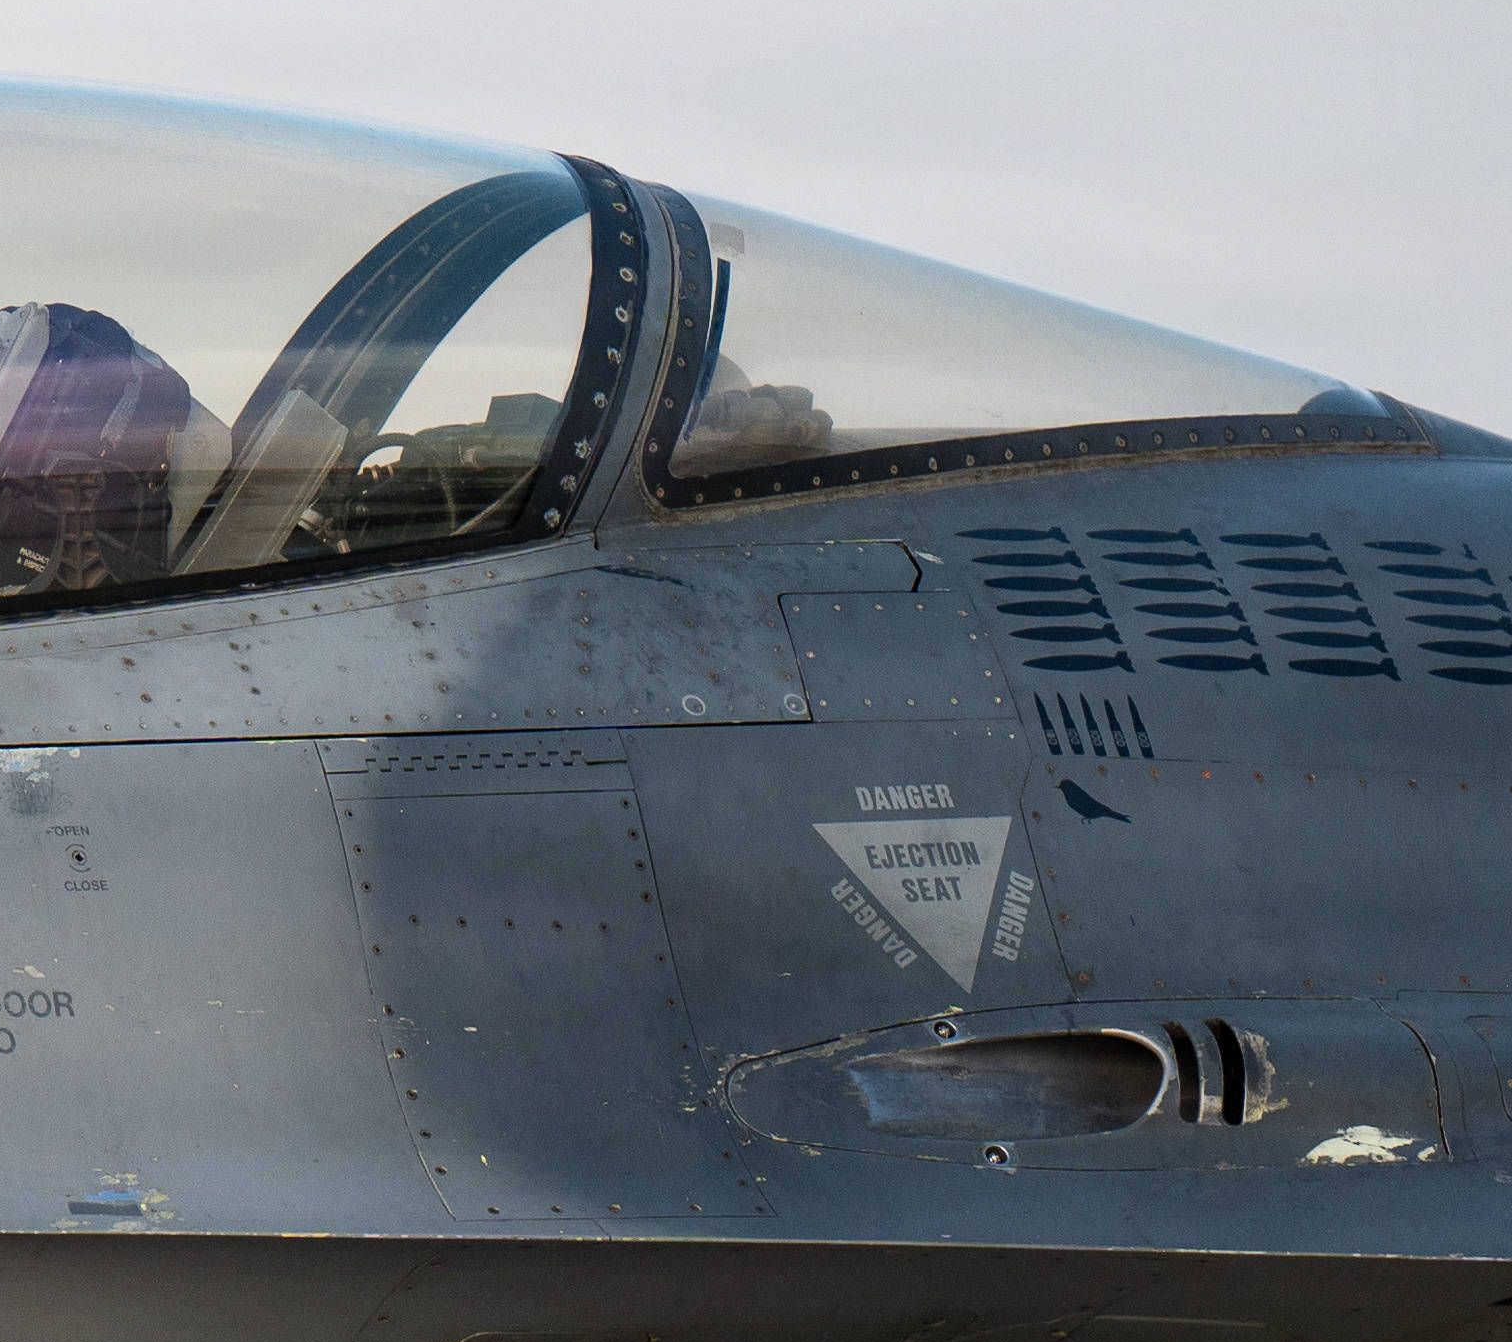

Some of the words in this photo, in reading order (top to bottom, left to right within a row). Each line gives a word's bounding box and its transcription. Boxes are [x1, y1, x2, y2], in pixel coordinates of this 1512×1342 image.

[855, 783, 956, 812] DANGER
[54, 826, 90, 836] OPEN
[864, 841, 981, 870] EJECTION
[64, 880, 109, 891] CLOSE
[901, 876, 964, 903] SEAT
[830, 876, 919, 970] DANGER
[991, 870, 1035, 963] DANGER
